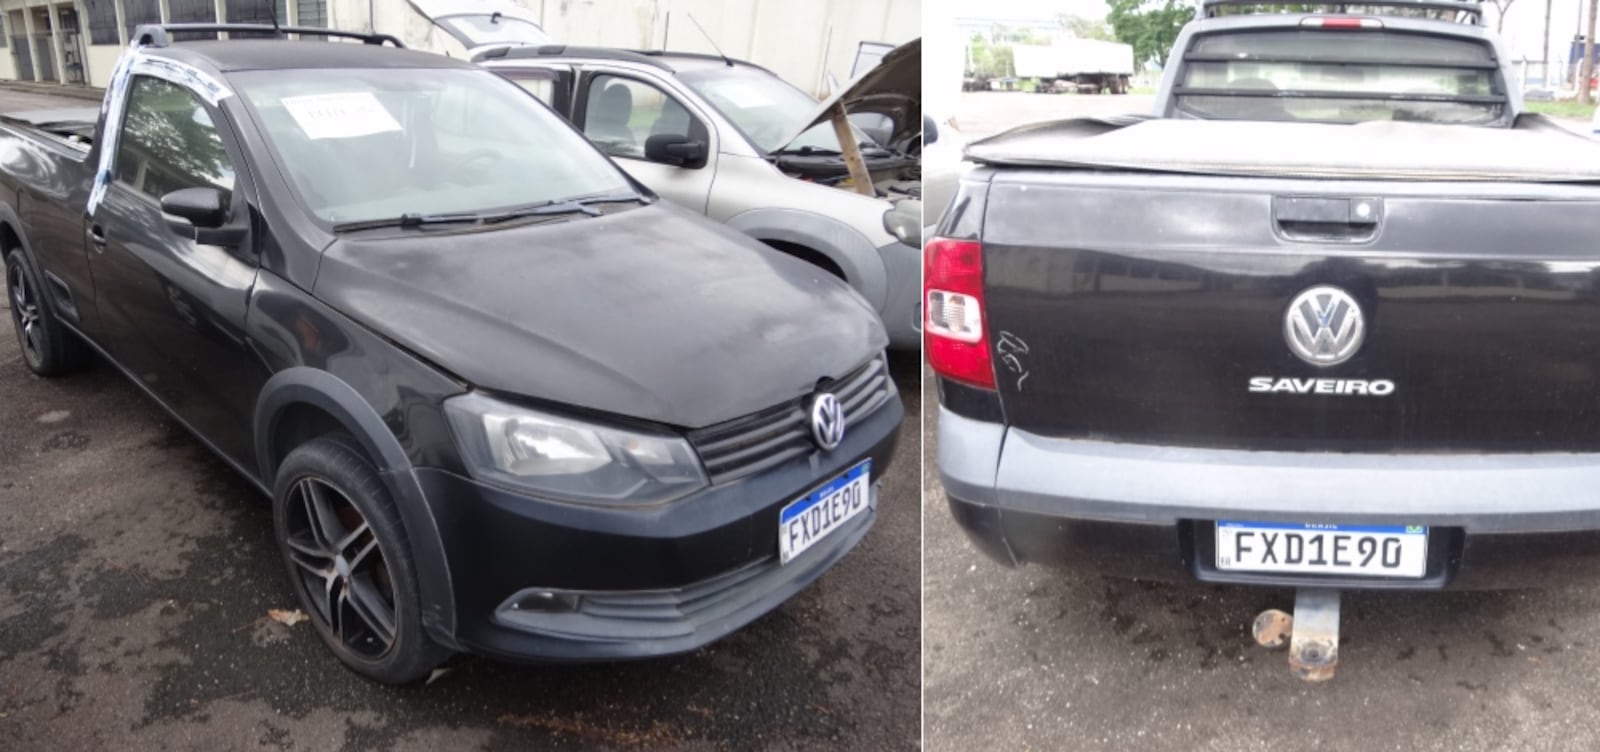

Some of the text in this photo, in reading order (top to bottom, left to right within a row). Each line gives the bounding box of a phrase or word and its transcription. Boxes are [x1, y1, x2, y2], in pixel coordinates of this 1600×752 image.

[1249, 376, 1395, 396] SAVEIRO
[789, 480, 862, 553] FXD1E90
[1235, 531, 1403, 569] FXD1E90
